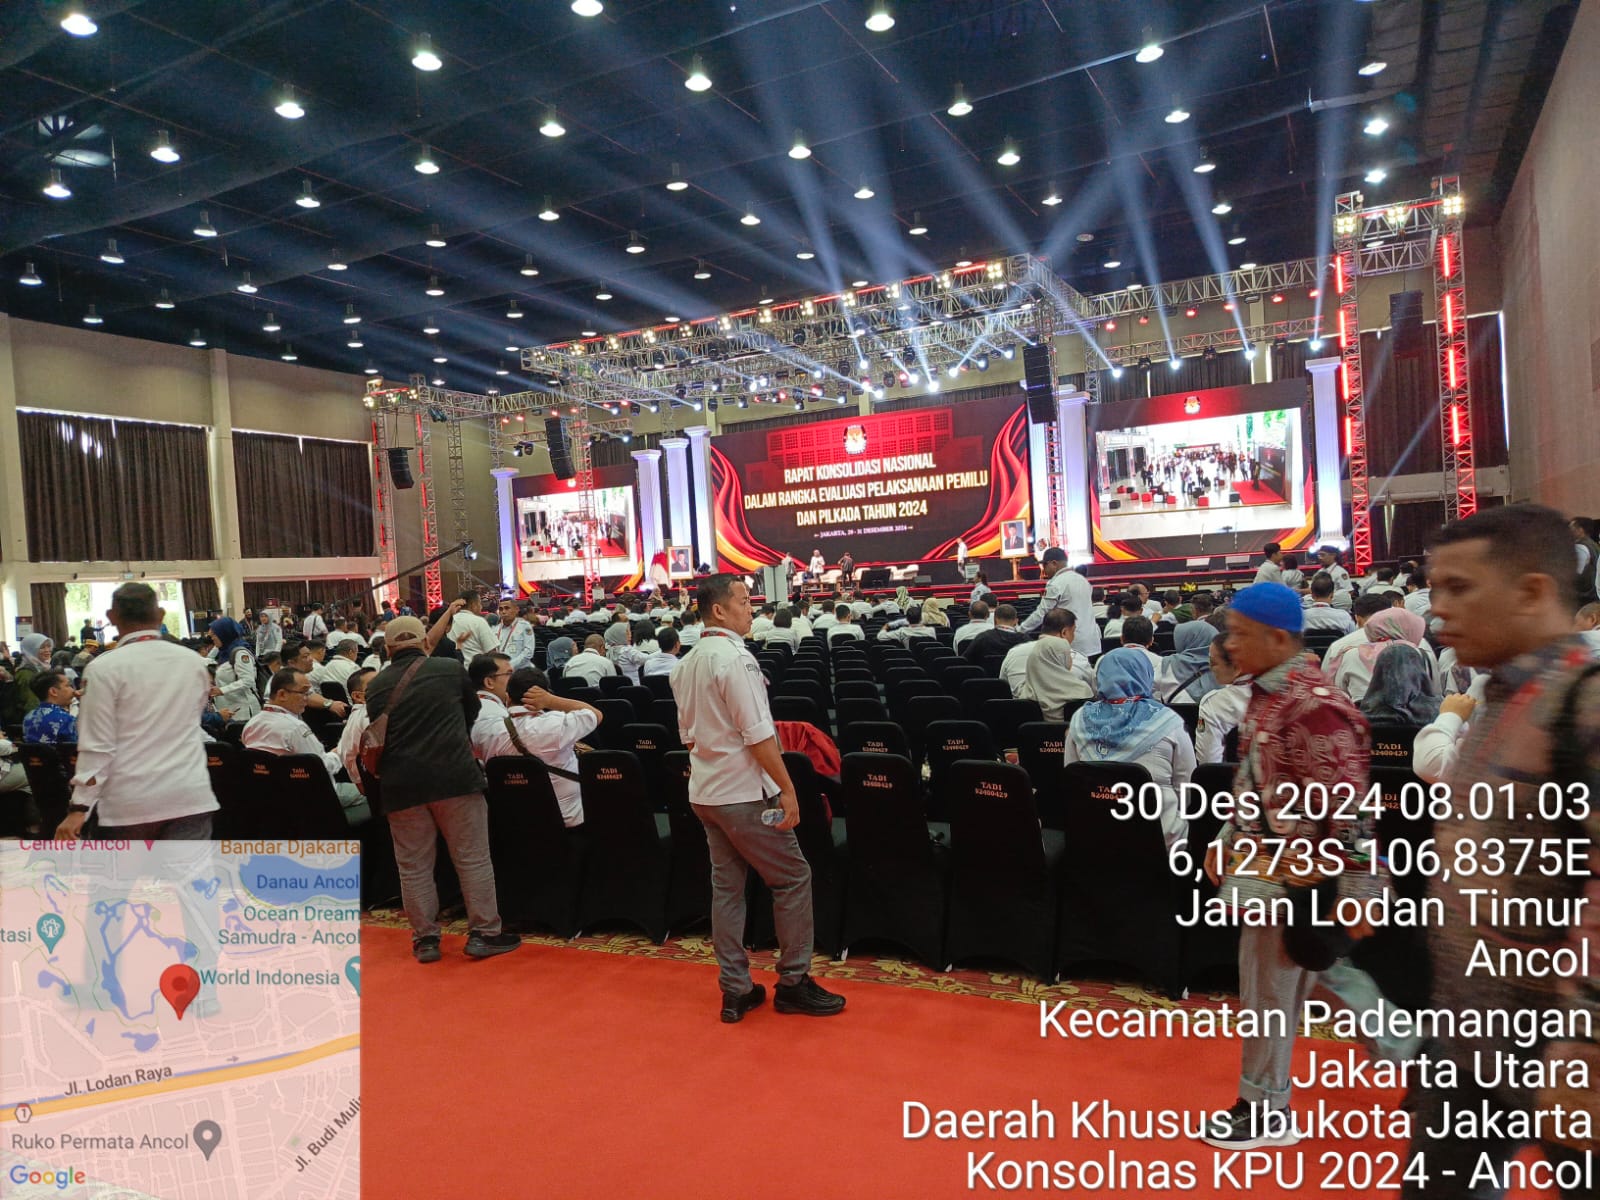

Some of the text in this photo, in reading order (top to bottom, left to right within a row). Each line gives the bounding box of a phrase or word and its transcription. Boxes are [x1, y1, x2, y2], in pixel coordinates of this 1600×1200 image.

[784, 453, 936, 484] RAPAT KONSOLIDASI NASIONAL
[744, 470, 988, 510] DALAM RANGKA EVALUASI PELAKSANAAN PEMILU
[796, 500, 928, 526] DAN PILKADA TAHUN 2024
[867, 774, 886, 782] TADI
[980, 782, 1002, 791] TADI
